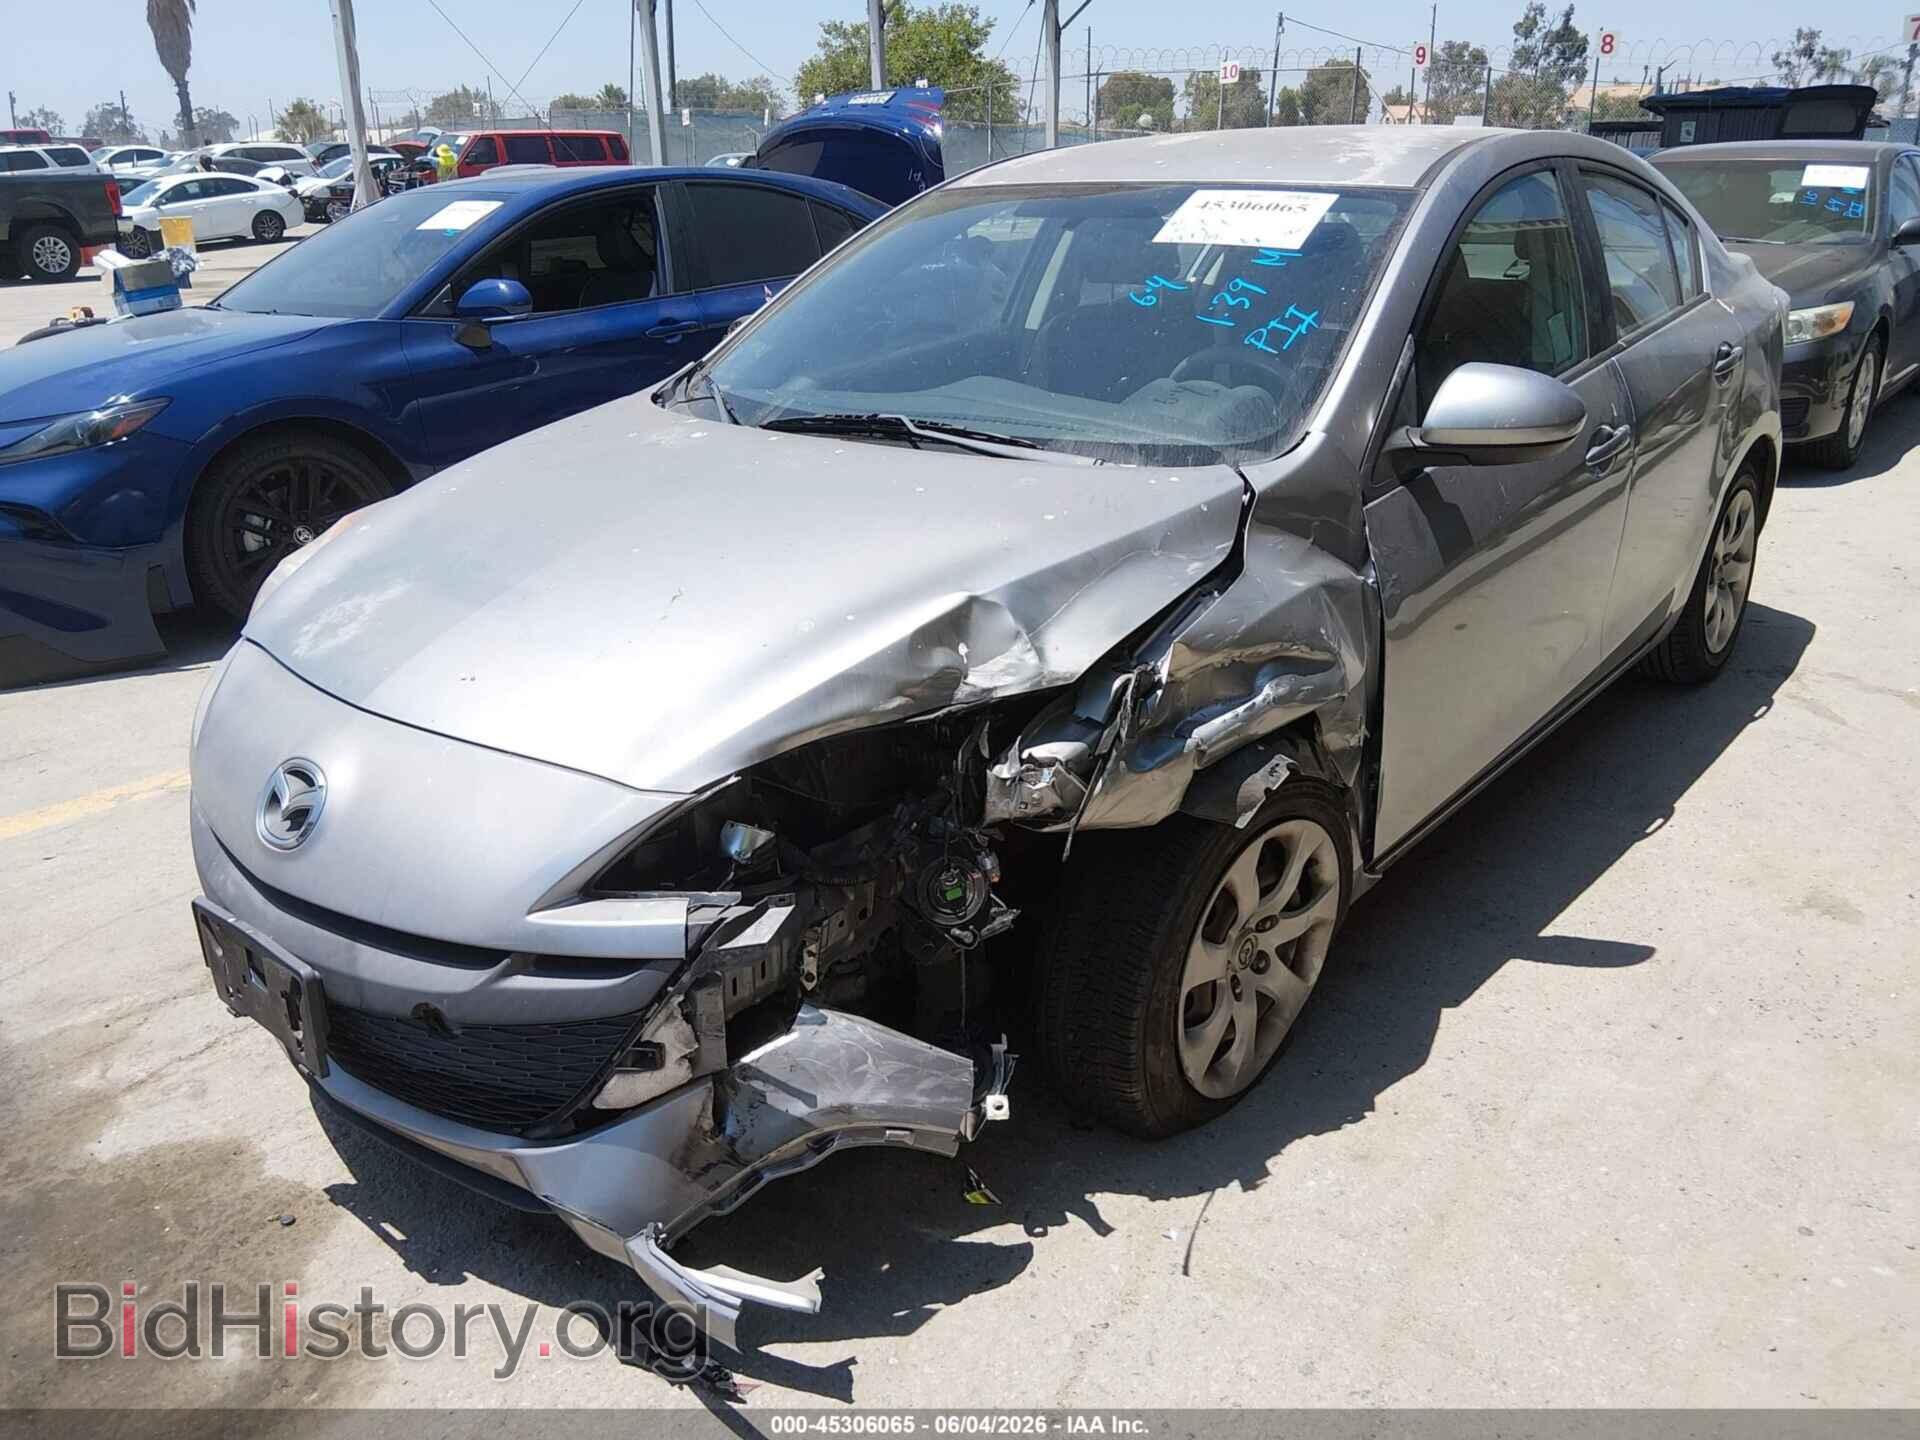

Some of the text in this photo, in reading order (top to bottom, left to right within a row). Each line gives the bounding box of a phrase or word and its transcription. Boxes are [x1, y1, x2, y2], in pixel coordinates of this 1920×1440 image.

[1601, 34, 1614, 54] 8
[1416, 46, 1426, 65] 9
[1221, 64, 1238, 80] 10
